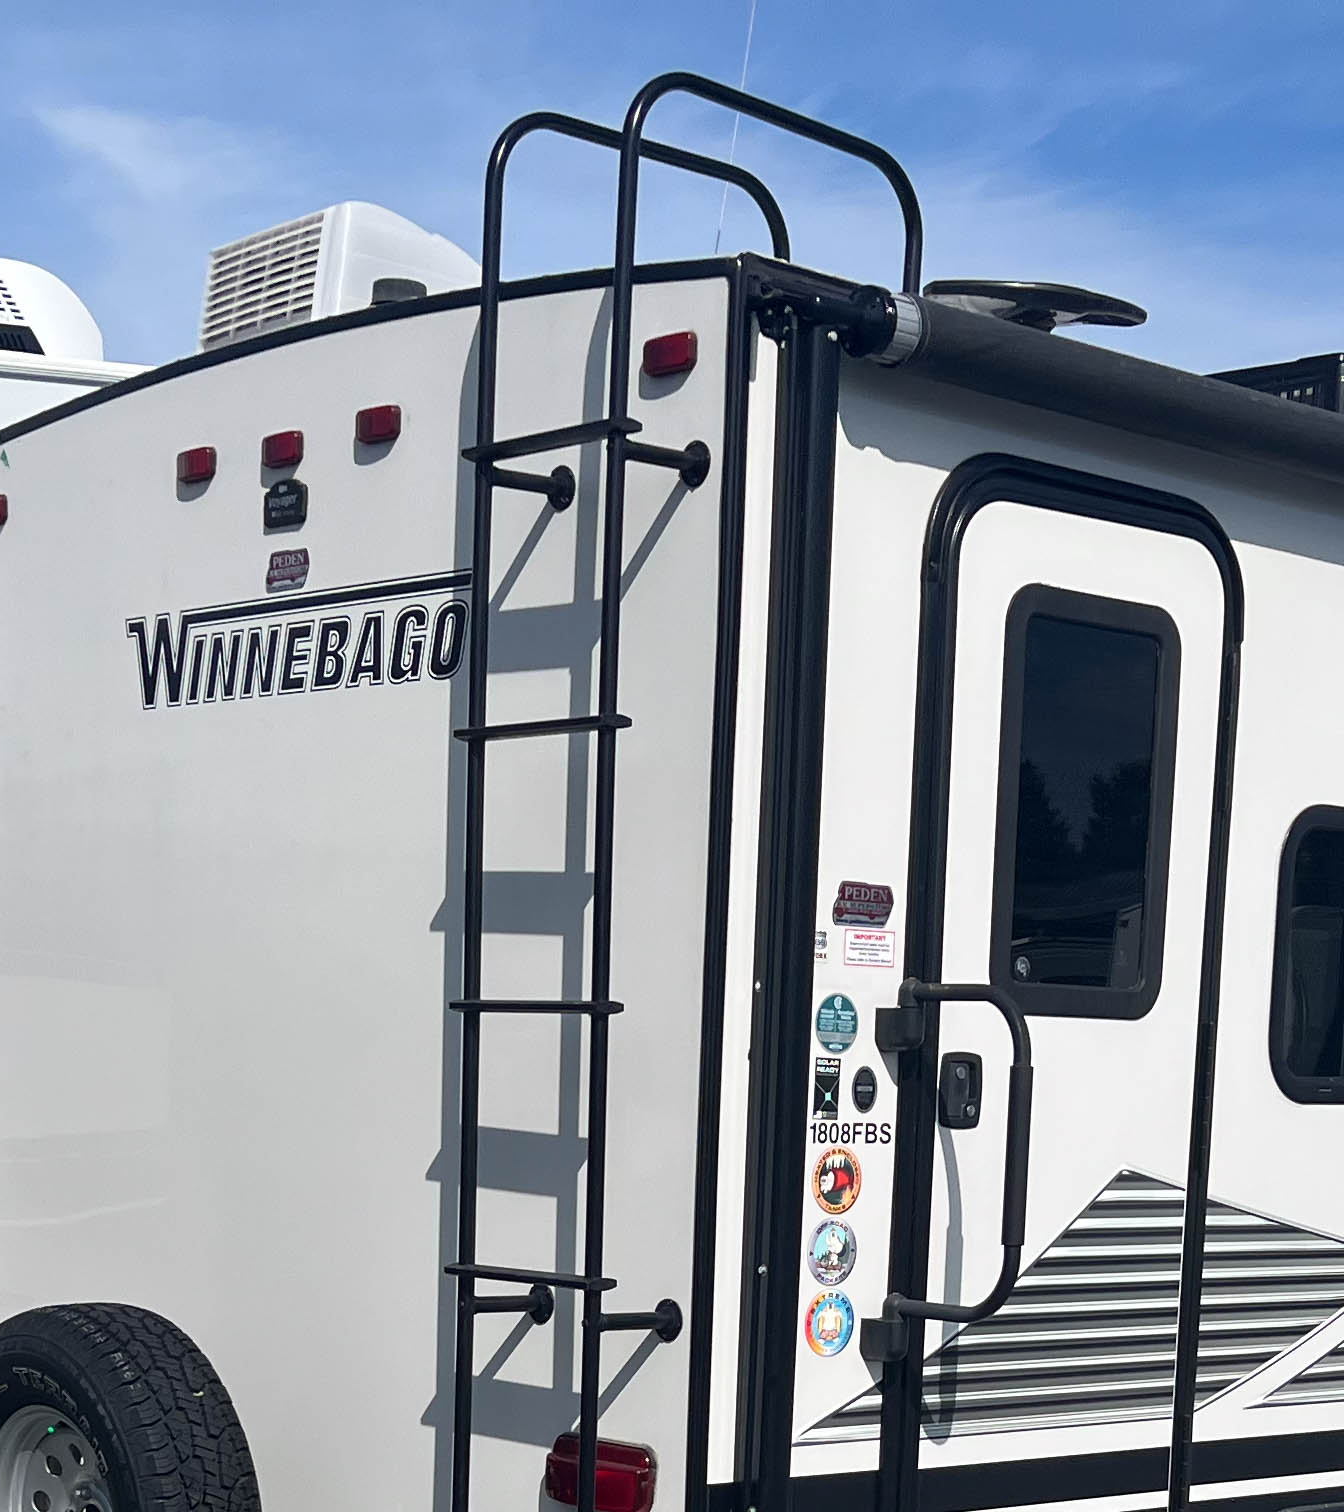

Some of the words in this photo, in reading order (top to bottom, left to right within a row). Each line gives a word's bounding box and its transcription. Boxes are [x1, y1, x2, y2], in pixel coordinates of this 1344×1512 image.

[273, 552, 304, 568] PEDEN
[126, 596, 470, 711] WINNEBAGO
[845, 886, 888, 902] PEDEN
[809, 1122, 891, 1144] 1808FBS
